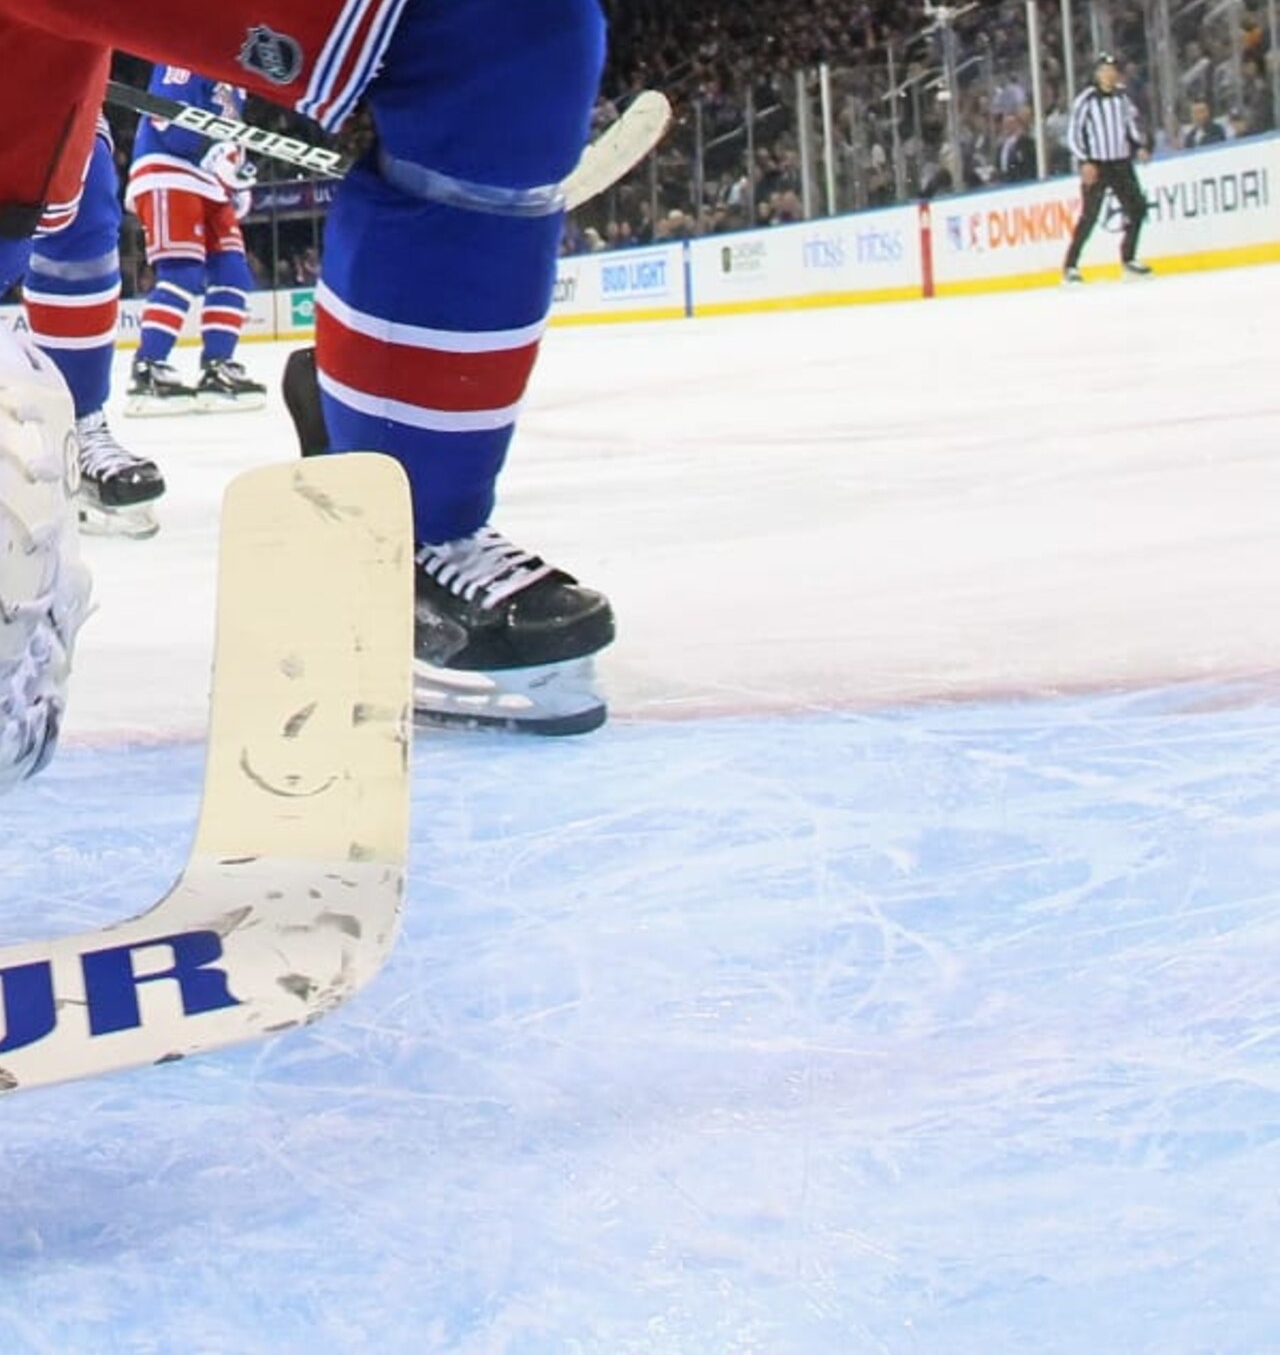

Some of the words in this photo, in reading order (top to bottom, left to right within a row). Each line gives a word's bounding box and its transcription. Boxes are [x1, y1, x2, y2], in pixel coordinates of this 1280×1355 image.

[175, 102, 343, 178] BAUER
[1145, 167, 1270, 224] HYUNDAI
[601, 264, 628, 292] BUD
[629, 260, 667, 289] LIGHT
